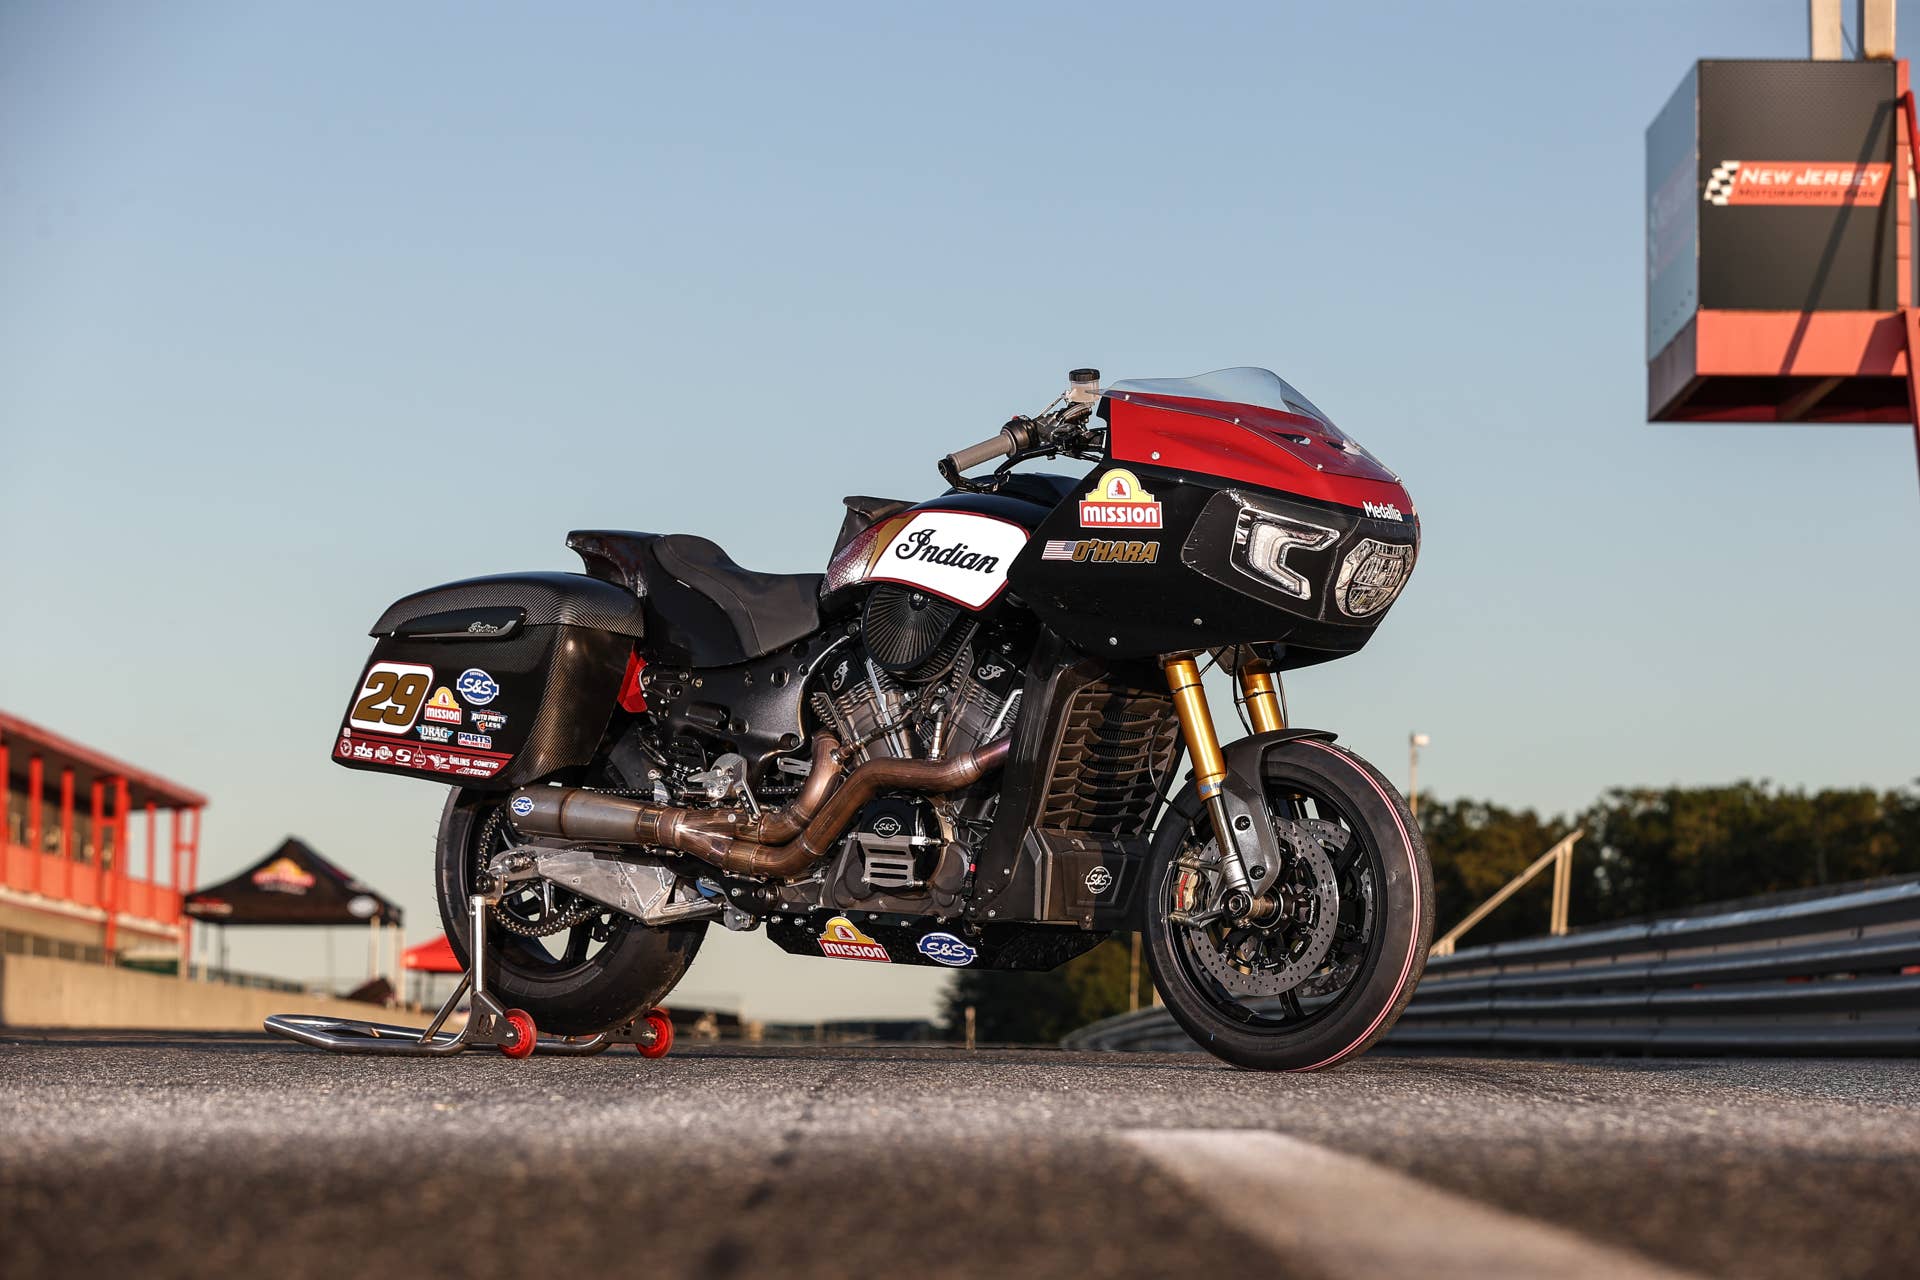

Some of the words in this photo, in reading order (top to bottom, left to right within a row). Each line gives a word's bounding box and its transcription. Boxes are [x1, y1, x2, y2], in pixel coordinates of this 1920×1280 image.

[1740, 168, 1792, 185] NEW
[1796, 169, 1883, 187] JERSEY
[1083, 505, 1158, 523] MISSION
[1362, 500, 1403, 522] Medallia
[895, 529, 999, 574] Indian
[1072, 539, 1160, 563] O'HARA
[462, 677, 492, 695] S&S
[352, 671, 429, 726] 29
[426, 707, 460, 721] MISSION
[422, 726, 448, 738] DRAG
[459, 733, 491, 744] PARTS
[353, 742, 373, 758] sbs
[823, 942, 886, 958] MISSION
[926, 942, 966, 957] S&S
